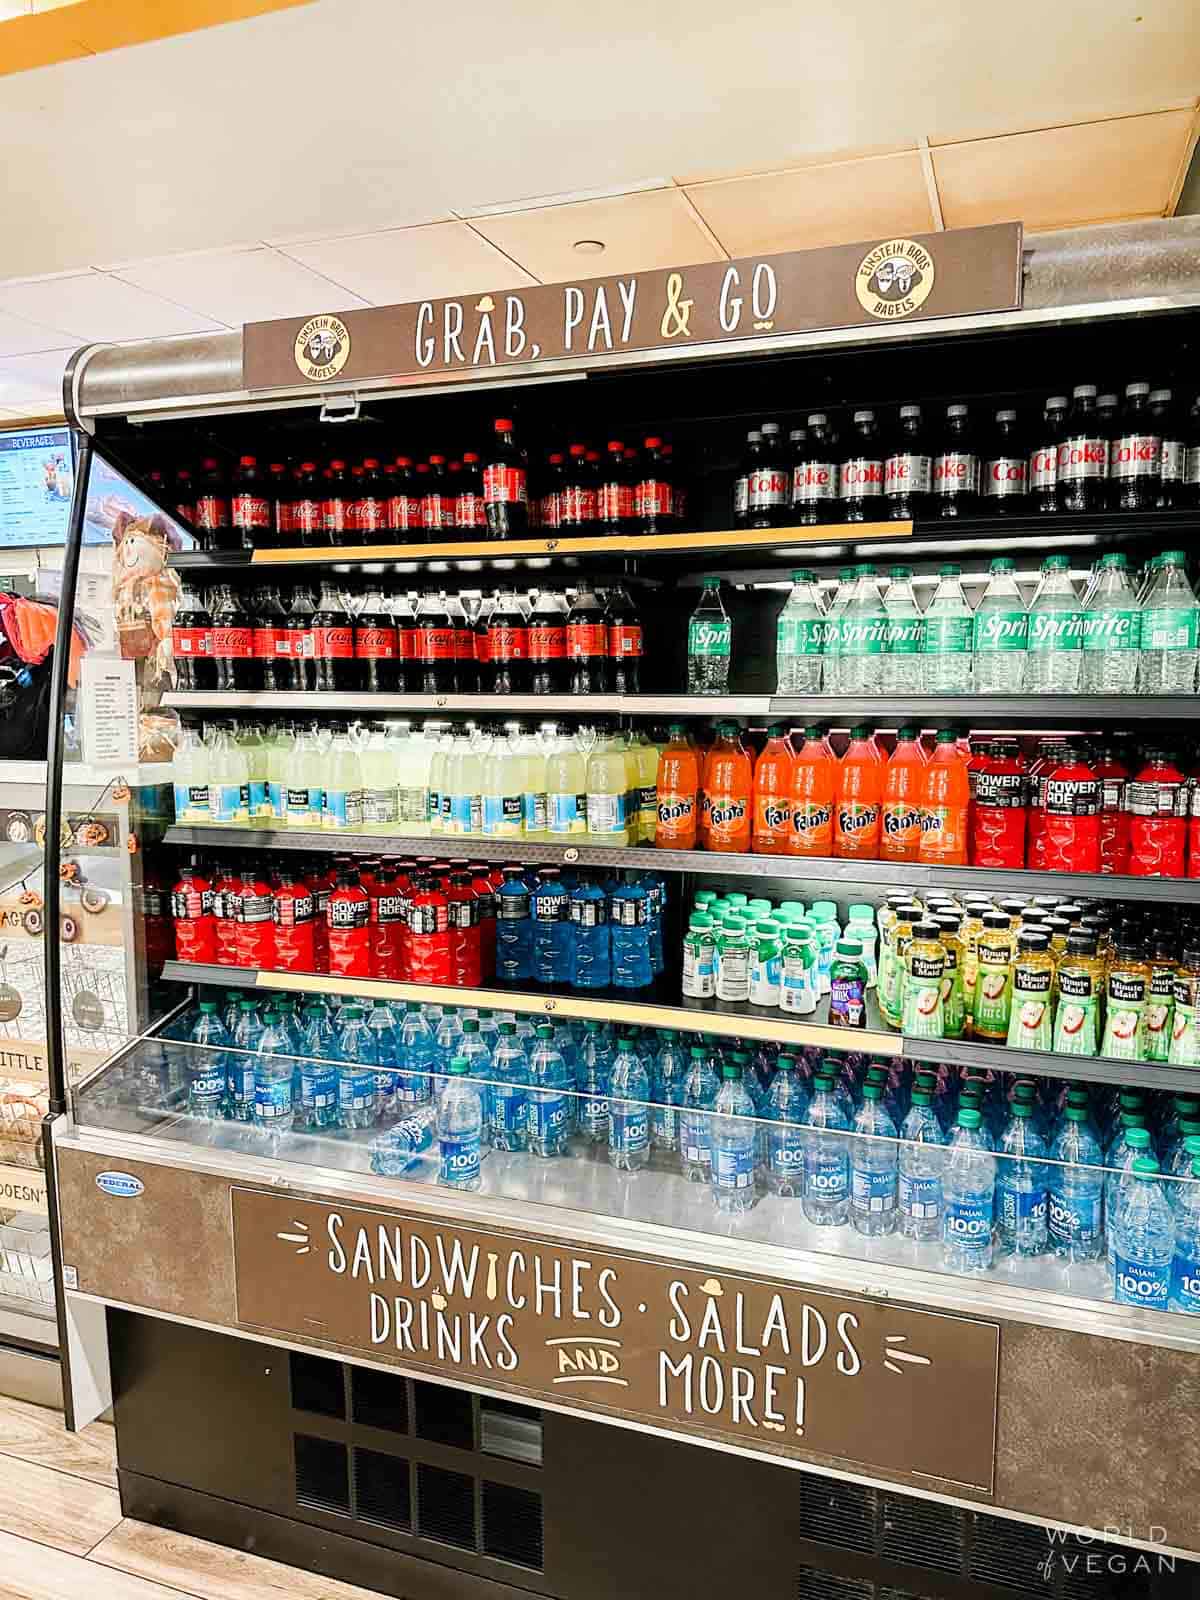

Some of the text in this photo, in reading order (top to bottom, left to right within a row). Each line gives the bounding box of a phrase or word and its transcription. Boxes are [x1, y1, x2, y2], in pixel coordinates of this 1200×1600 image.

[860, 241, 931, 278] EINSTEIN BROS
[873, 296, 916, 318] BAGELS
[415, 263, 778, 368] GRAB, PAY & GO
[297, 318, 347, 346] EINSTEIN BROS
[307, 365, 337, 379] BAGELS
[976, 774, 1020, 787] POWER
[1047, 781, 1096, 794] POWER
[658, 802, 691, 822] Fanta
[711, 805, 744, 826] Fanta
[793, 809, 830, 832] Fanta
[840, 812, 877, 833] Fanta
[918, 968, 940, 976] Maid
[1017, 972, 1049, 983] Minute
[1022, 981, 1046, 990] Maid
[1060, 974, 1088, 987] Minute
[1111, 981, 1142, 992] Minute
[1063, 984, 1085, 994] Maid
[1114, 990, 1138, 999] Maid
[192, 1079, 225, 1091] 100%
[585, 1102, 608, 1114] 100
[624, 1126, 647, 1138] 100
[450, 1154, 479, 1167] 100
[776, 1149, 803, 1162] 100
[96, 1178, 143, 1190] FEDERAL
[947, 1216, 990, 1234] 100%
[1128, 1266, 1156, 1278] DASANI
[1117, 1273, 1168, 1296] 100%
[1181, 1276, 1200, 1294] 10
[326, 1213, 862, 1376] SANDWICHES SALADS
[369, 1292, 808, 1436] DRINKS AND MORE!
